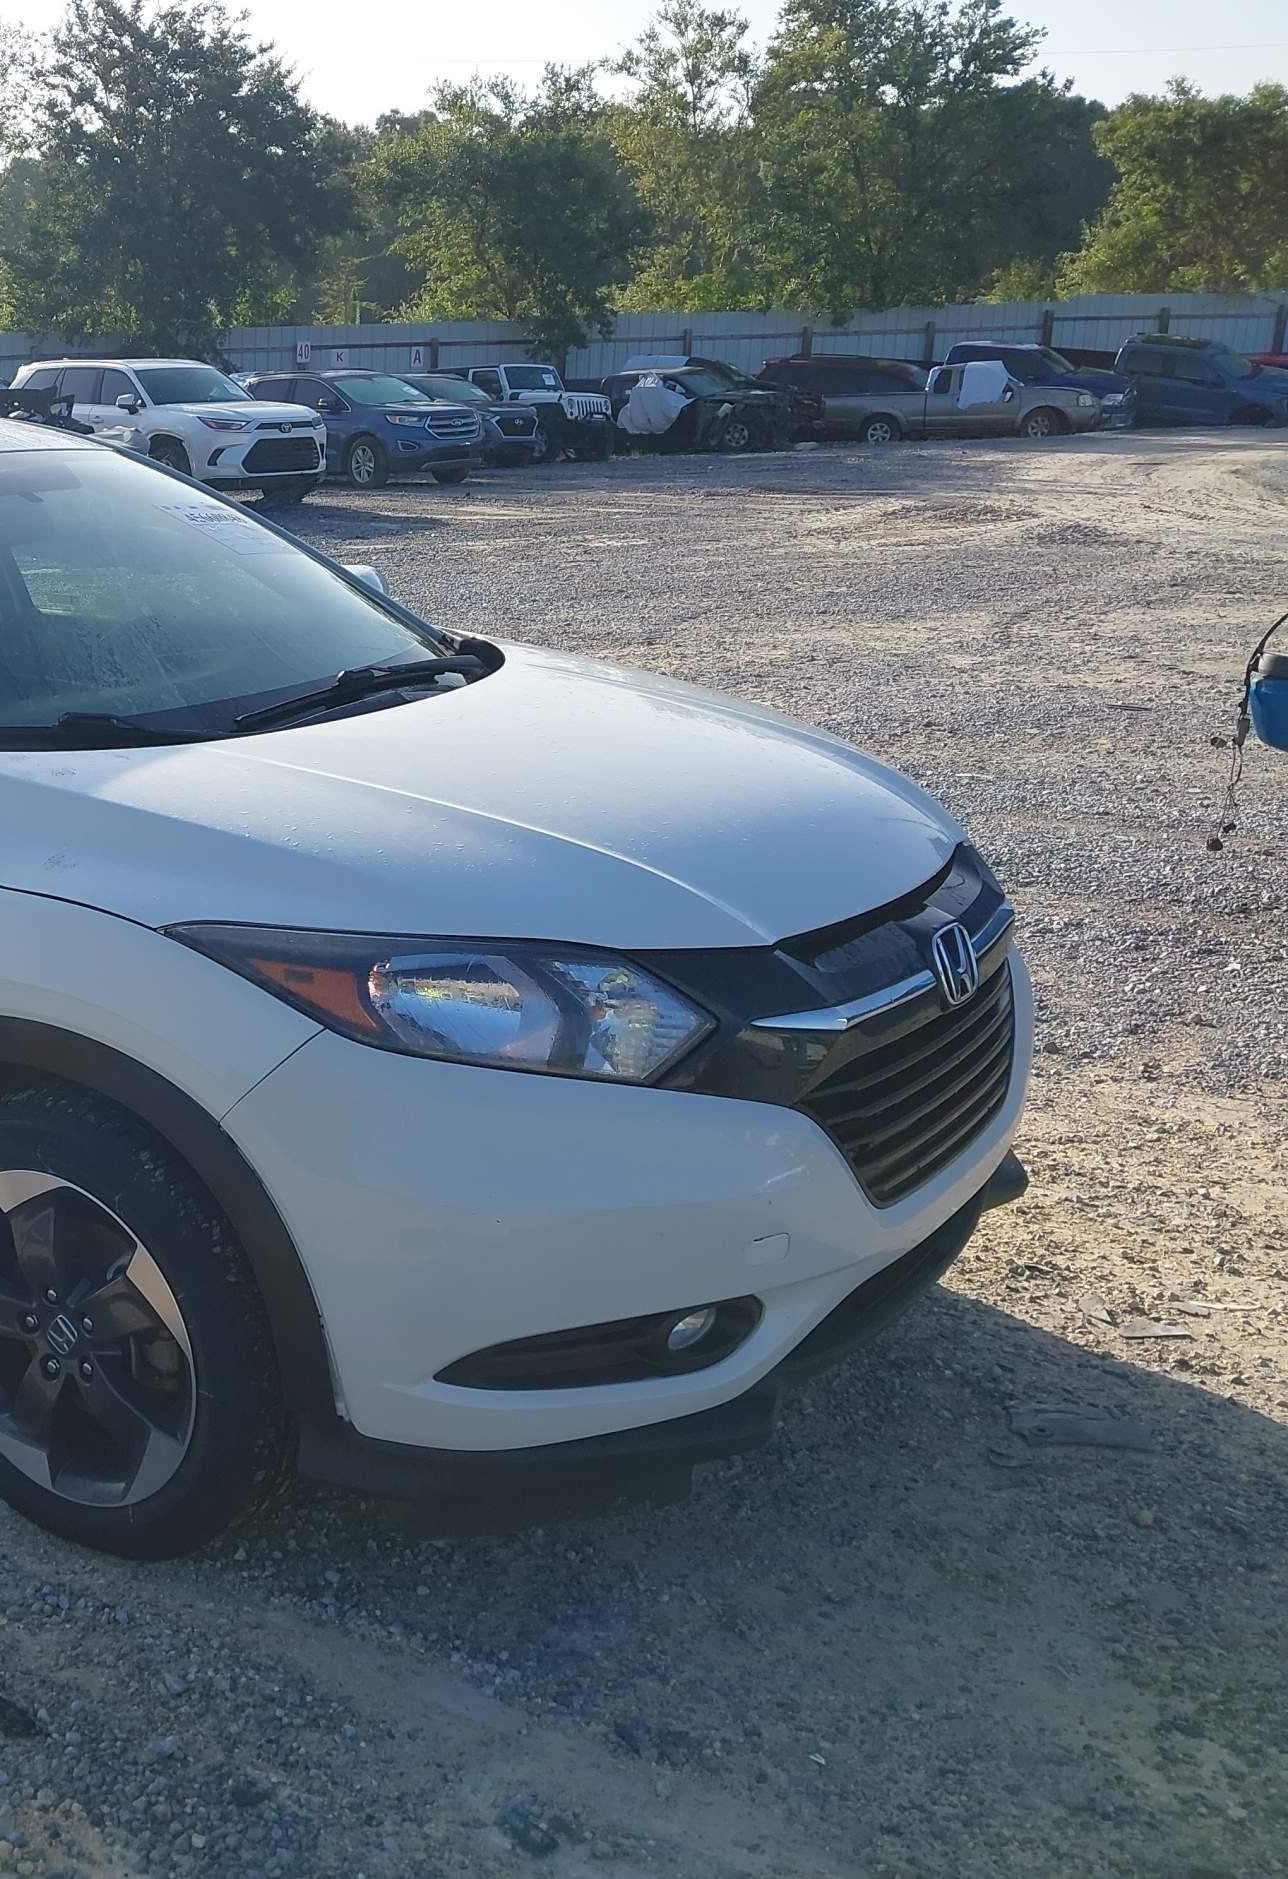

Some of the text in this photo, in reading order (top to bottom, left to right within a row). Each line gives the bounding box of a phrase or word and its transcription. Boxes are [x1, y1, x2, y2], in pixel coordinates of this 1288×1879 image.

[297, 343, 310, 360] 40
[336, 351, 344, 362] K
[413, 349, 422, 364] A
